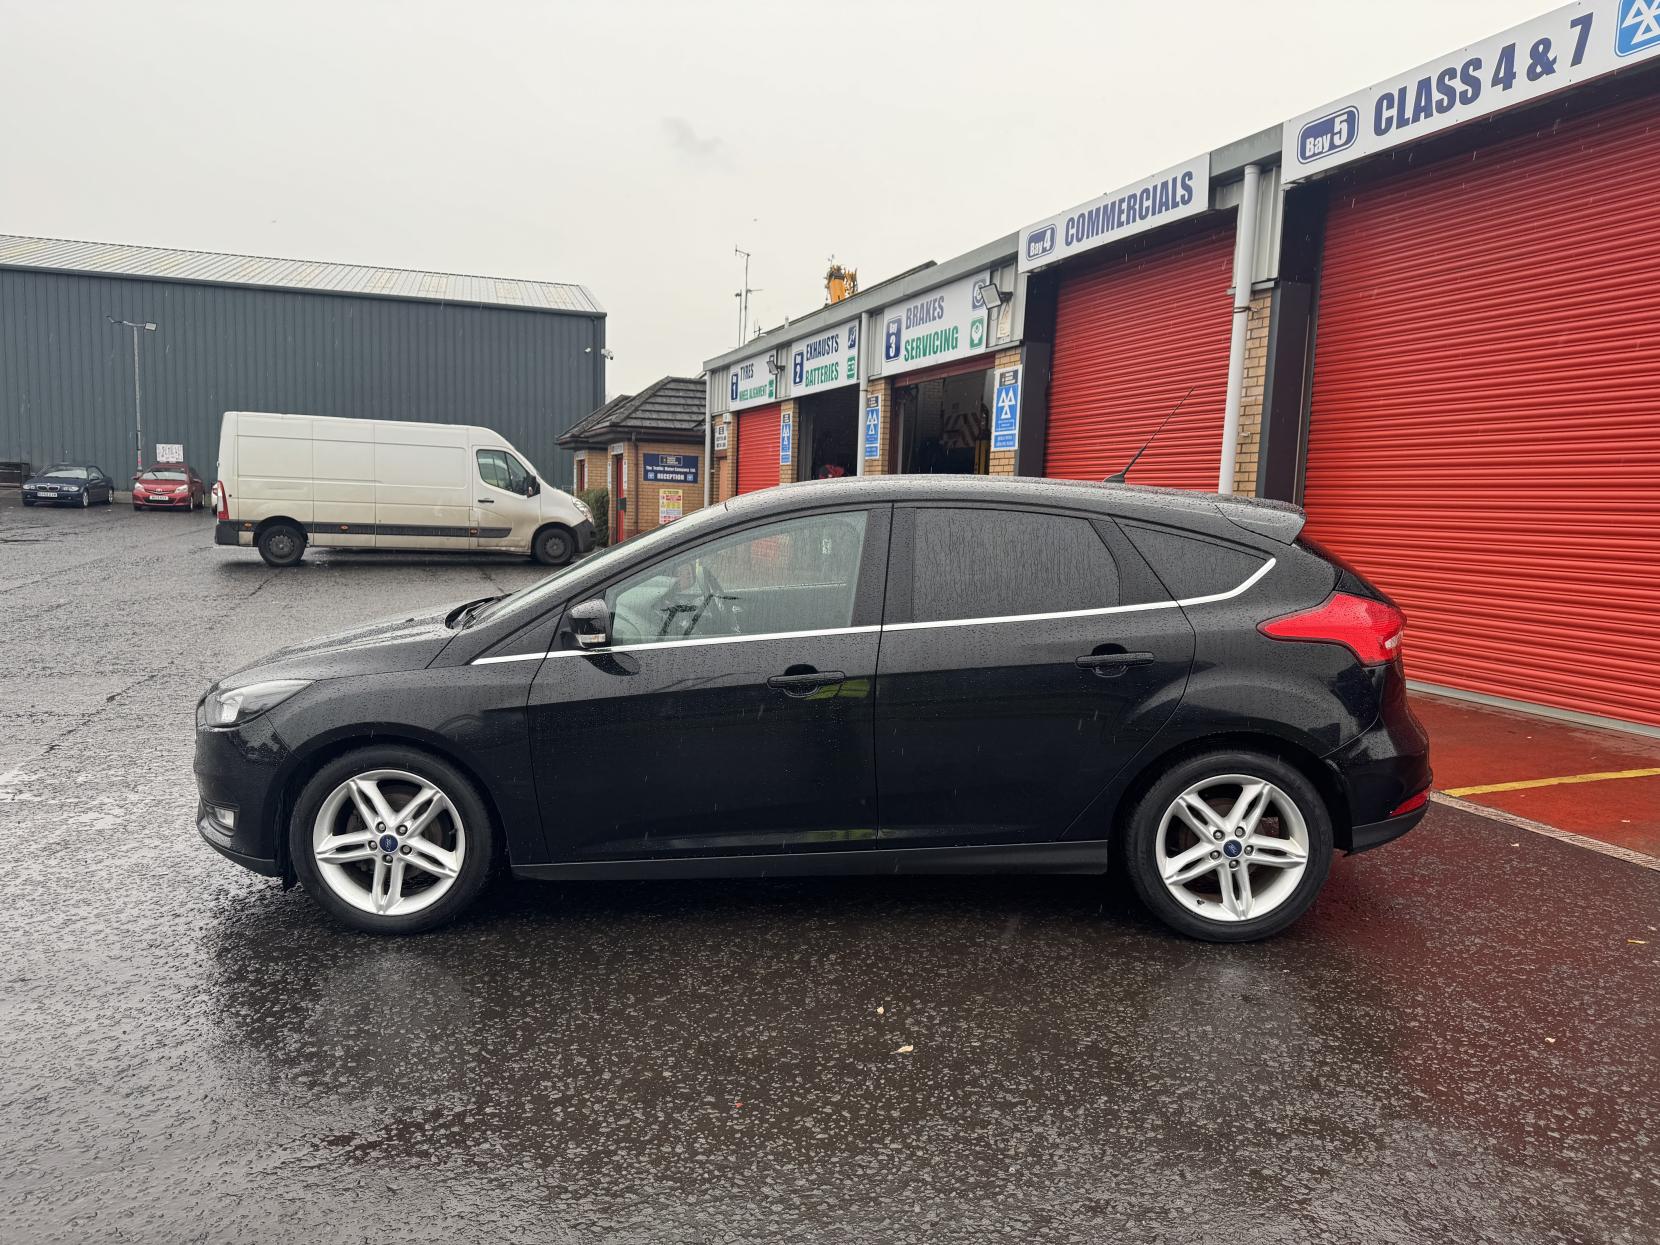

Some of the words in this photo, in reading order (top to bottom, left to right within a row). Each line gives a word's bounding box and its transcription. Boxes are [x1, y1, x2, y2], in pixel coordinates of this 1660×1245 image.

[1373, 58, 1482, 137] CLASS
[1491, 42, 1517, 92] 4
[1526, 37, 1557, 82] &
[1570, 12, 1594, 68] 7
[1305, 135, 1331, 157] Bay
[1330, 110, 1349, 147] 5
[1064, 170, 1193, 246] COMMERCIALS
[1029, 241, 1043, 256] Bay
[1042, 229, 1052, 251] 4
[905, 296, 945, 330] BRAKES
[889, 322, 898, 334] Bay
[806, 333, 839, 361] EXHAUSTS
[889, 335, 896, 358] 3
[904, 325, 959, 362] SERVICING
[740, 363, 754, 382] TYRES
[805, 361, 839, 387] BATTERIES
